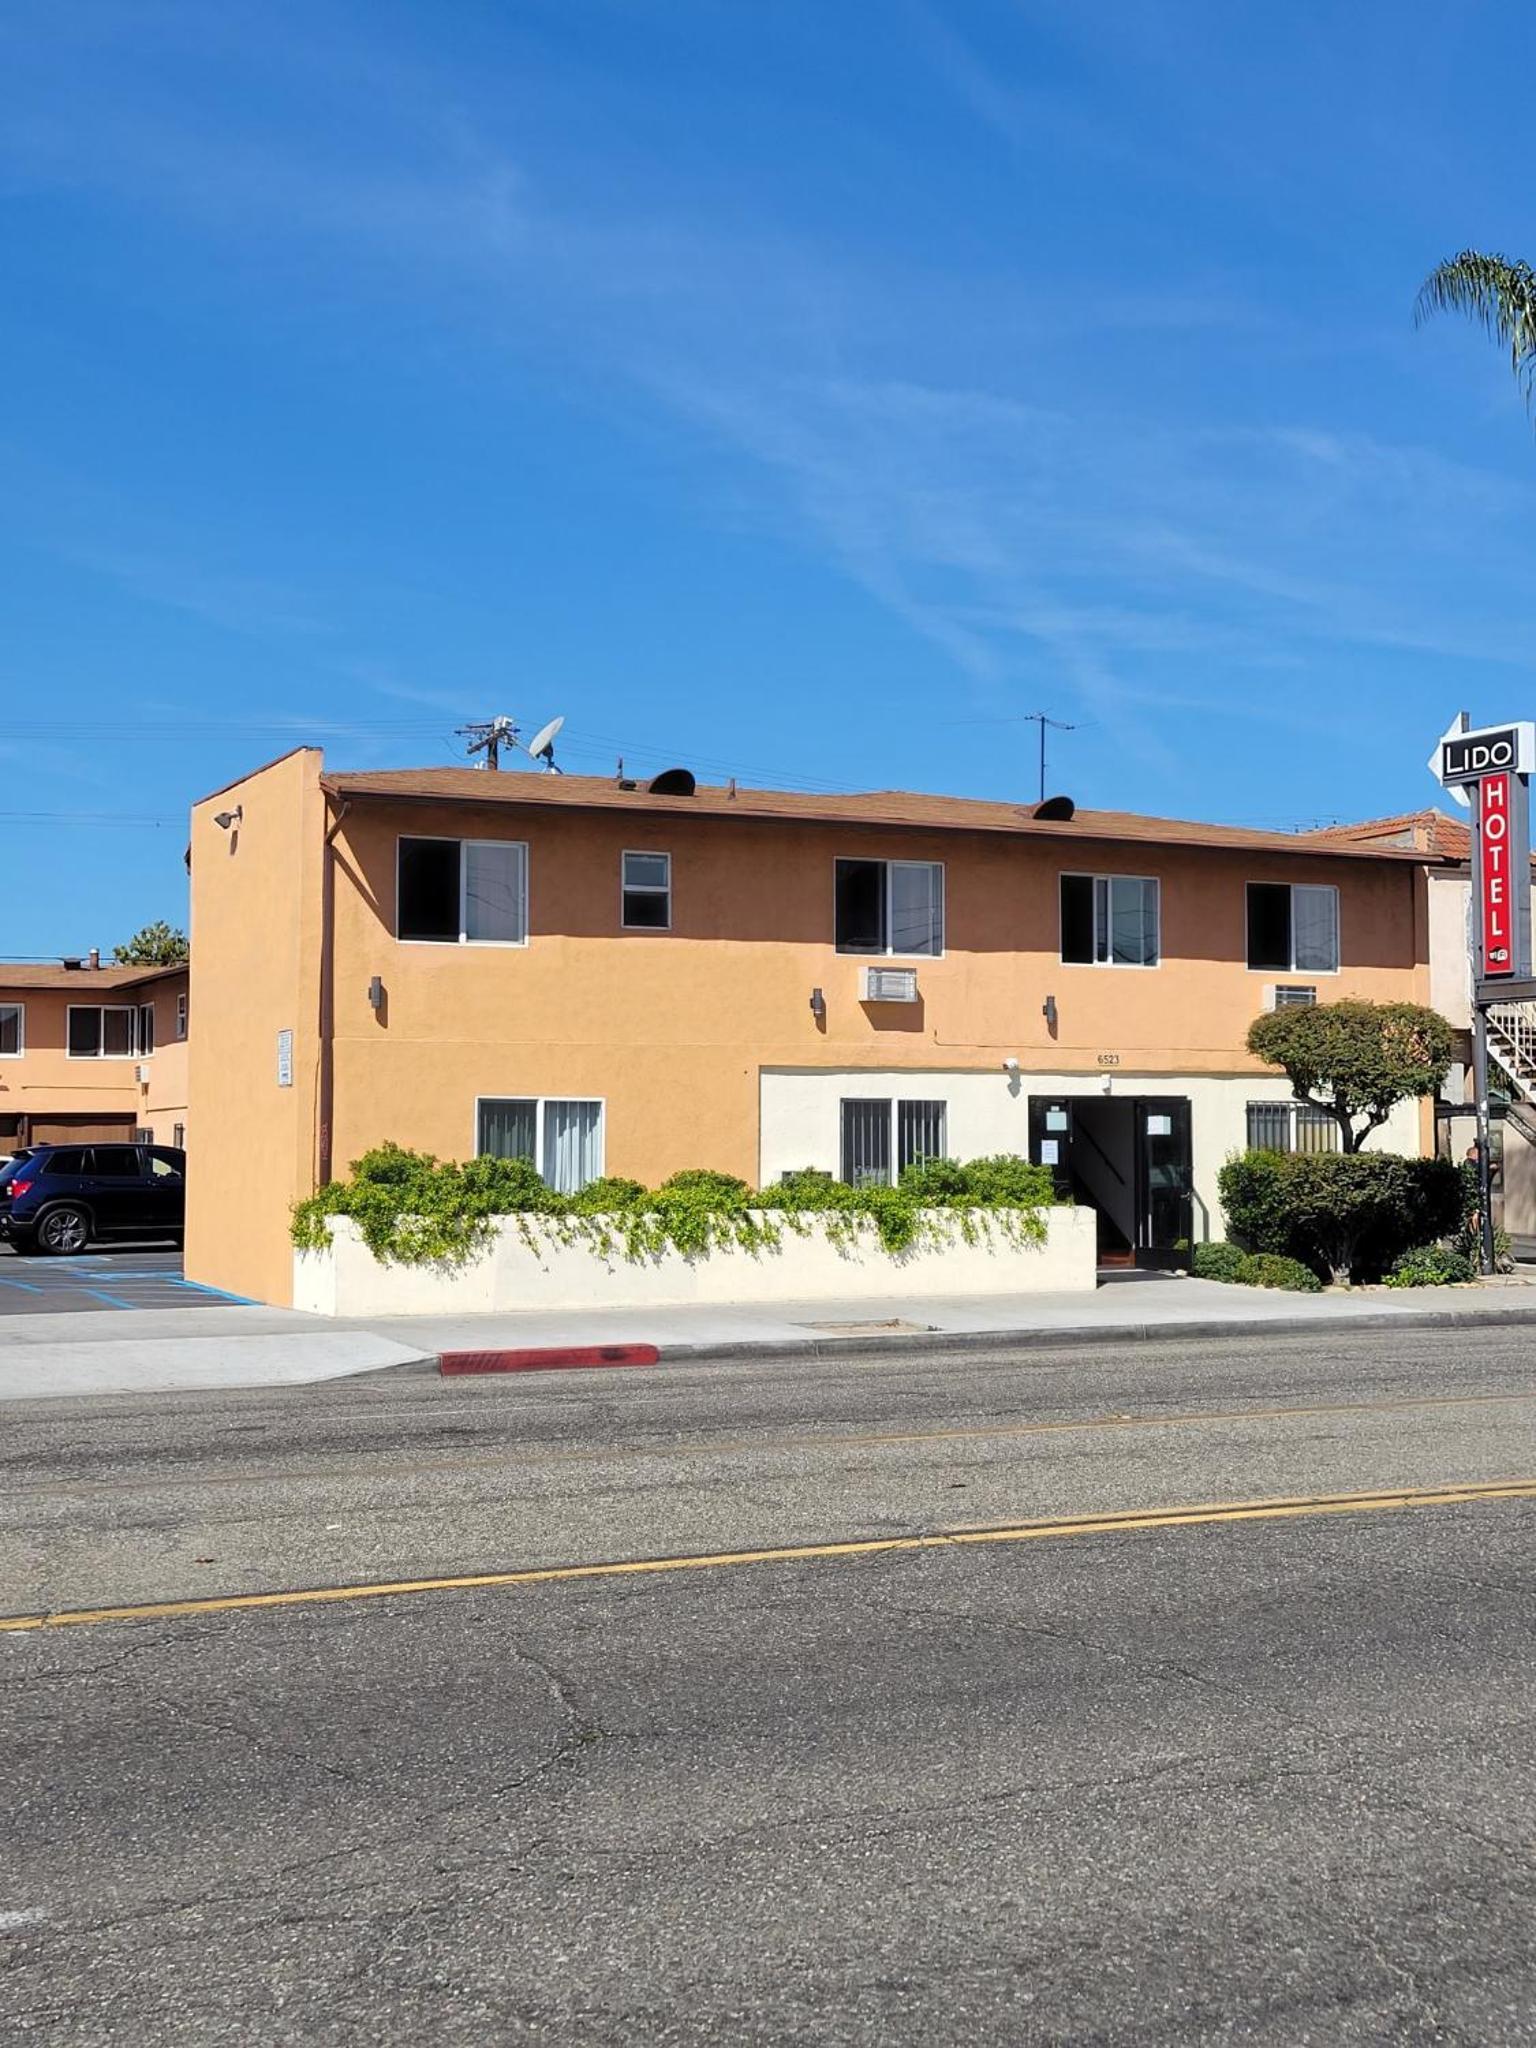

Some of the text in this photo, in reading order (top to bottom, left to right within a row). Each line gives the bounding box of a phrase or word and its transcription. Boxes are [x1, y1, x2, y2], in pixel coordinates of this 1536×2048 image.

[1446, 741, 1512, 773] LIDO
[1485, 781, 1506, 936] HOTEL
[1097, 1054, 1119, 1065] 6523
